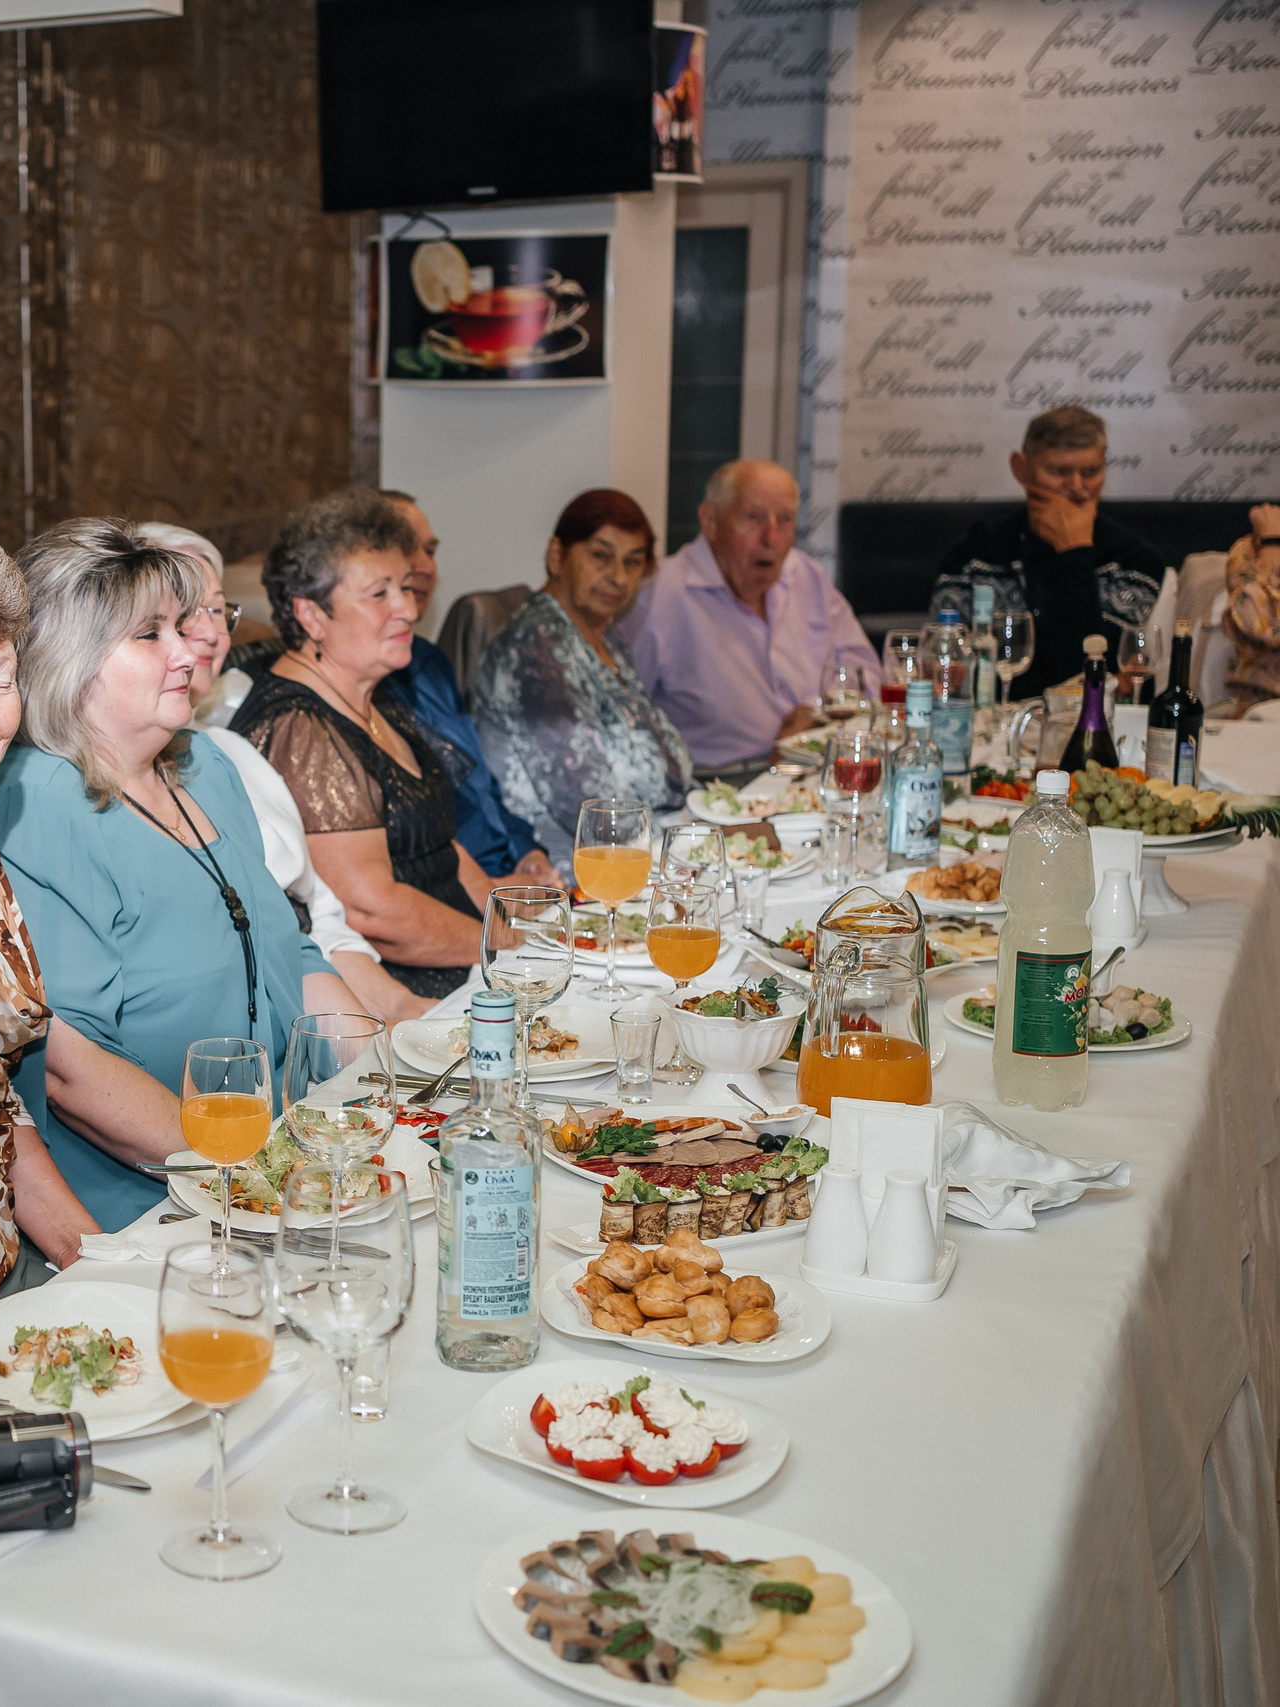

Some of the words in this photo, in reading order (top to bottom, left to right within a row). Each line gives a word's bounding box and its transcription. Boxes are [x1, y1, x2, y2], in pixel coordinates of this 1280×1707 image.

[475, 1062, 492, 1072] ICE
[463, 1294, 483, 1303] ВРЕДИТ
[483, 1294, 506, 1304] ВАШЕМУ
